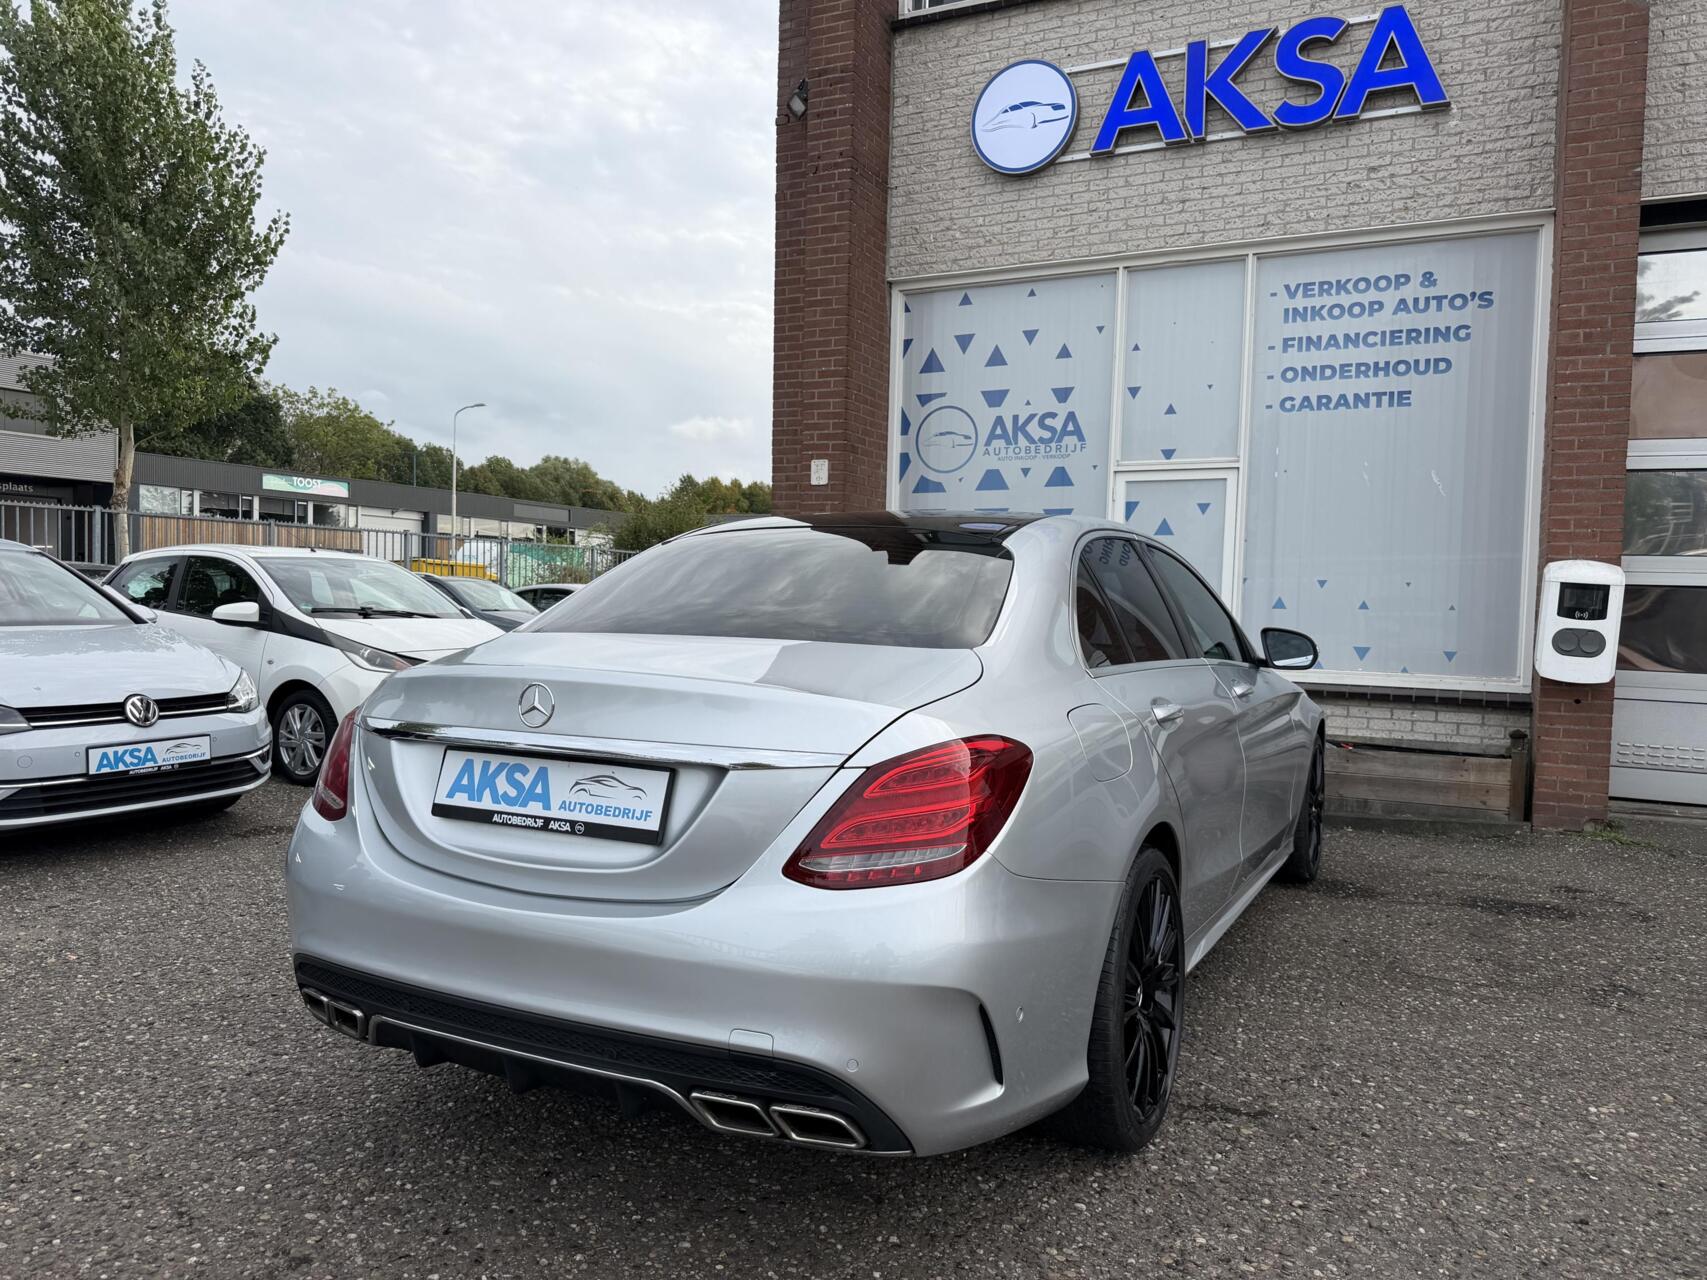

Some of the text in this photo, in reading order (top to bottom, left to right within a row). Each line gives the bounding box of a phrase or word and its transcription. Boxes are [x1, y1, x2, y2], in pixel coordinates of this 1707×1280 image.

[1090, 4, 1450, 155] AKSA
[1283, 273, 1411, 300] VERKOOP
[1419, 271, 1438, 289] &
[1283, 291, 1494, 324] INKOOP AUTO'S
[1282, 324, 1472, 353] FINANCIERING
[1280, 357, 1453, 383] ONDERHOUD
[1279, 390, 1412, 413] GARANTIE
[984, 410, 1086, 447] AKSA
[982, 443, 1087, 456] AUTOBEDRIJF
[0, 481, 34, 492] plaats
[292, 476, 322, 489] TOOST
[96, 746, 159, 772] AKSA
[162, 752, 207, 763] AUTOBEDRIJF
[445, 758, 552, 812] AKSA
[492, 813, 544, 828] AUTOBEDRIJF
[548, 820, 571, 832] AKSA
[558, 800, 653, 823] AUTOBEDRIJF
